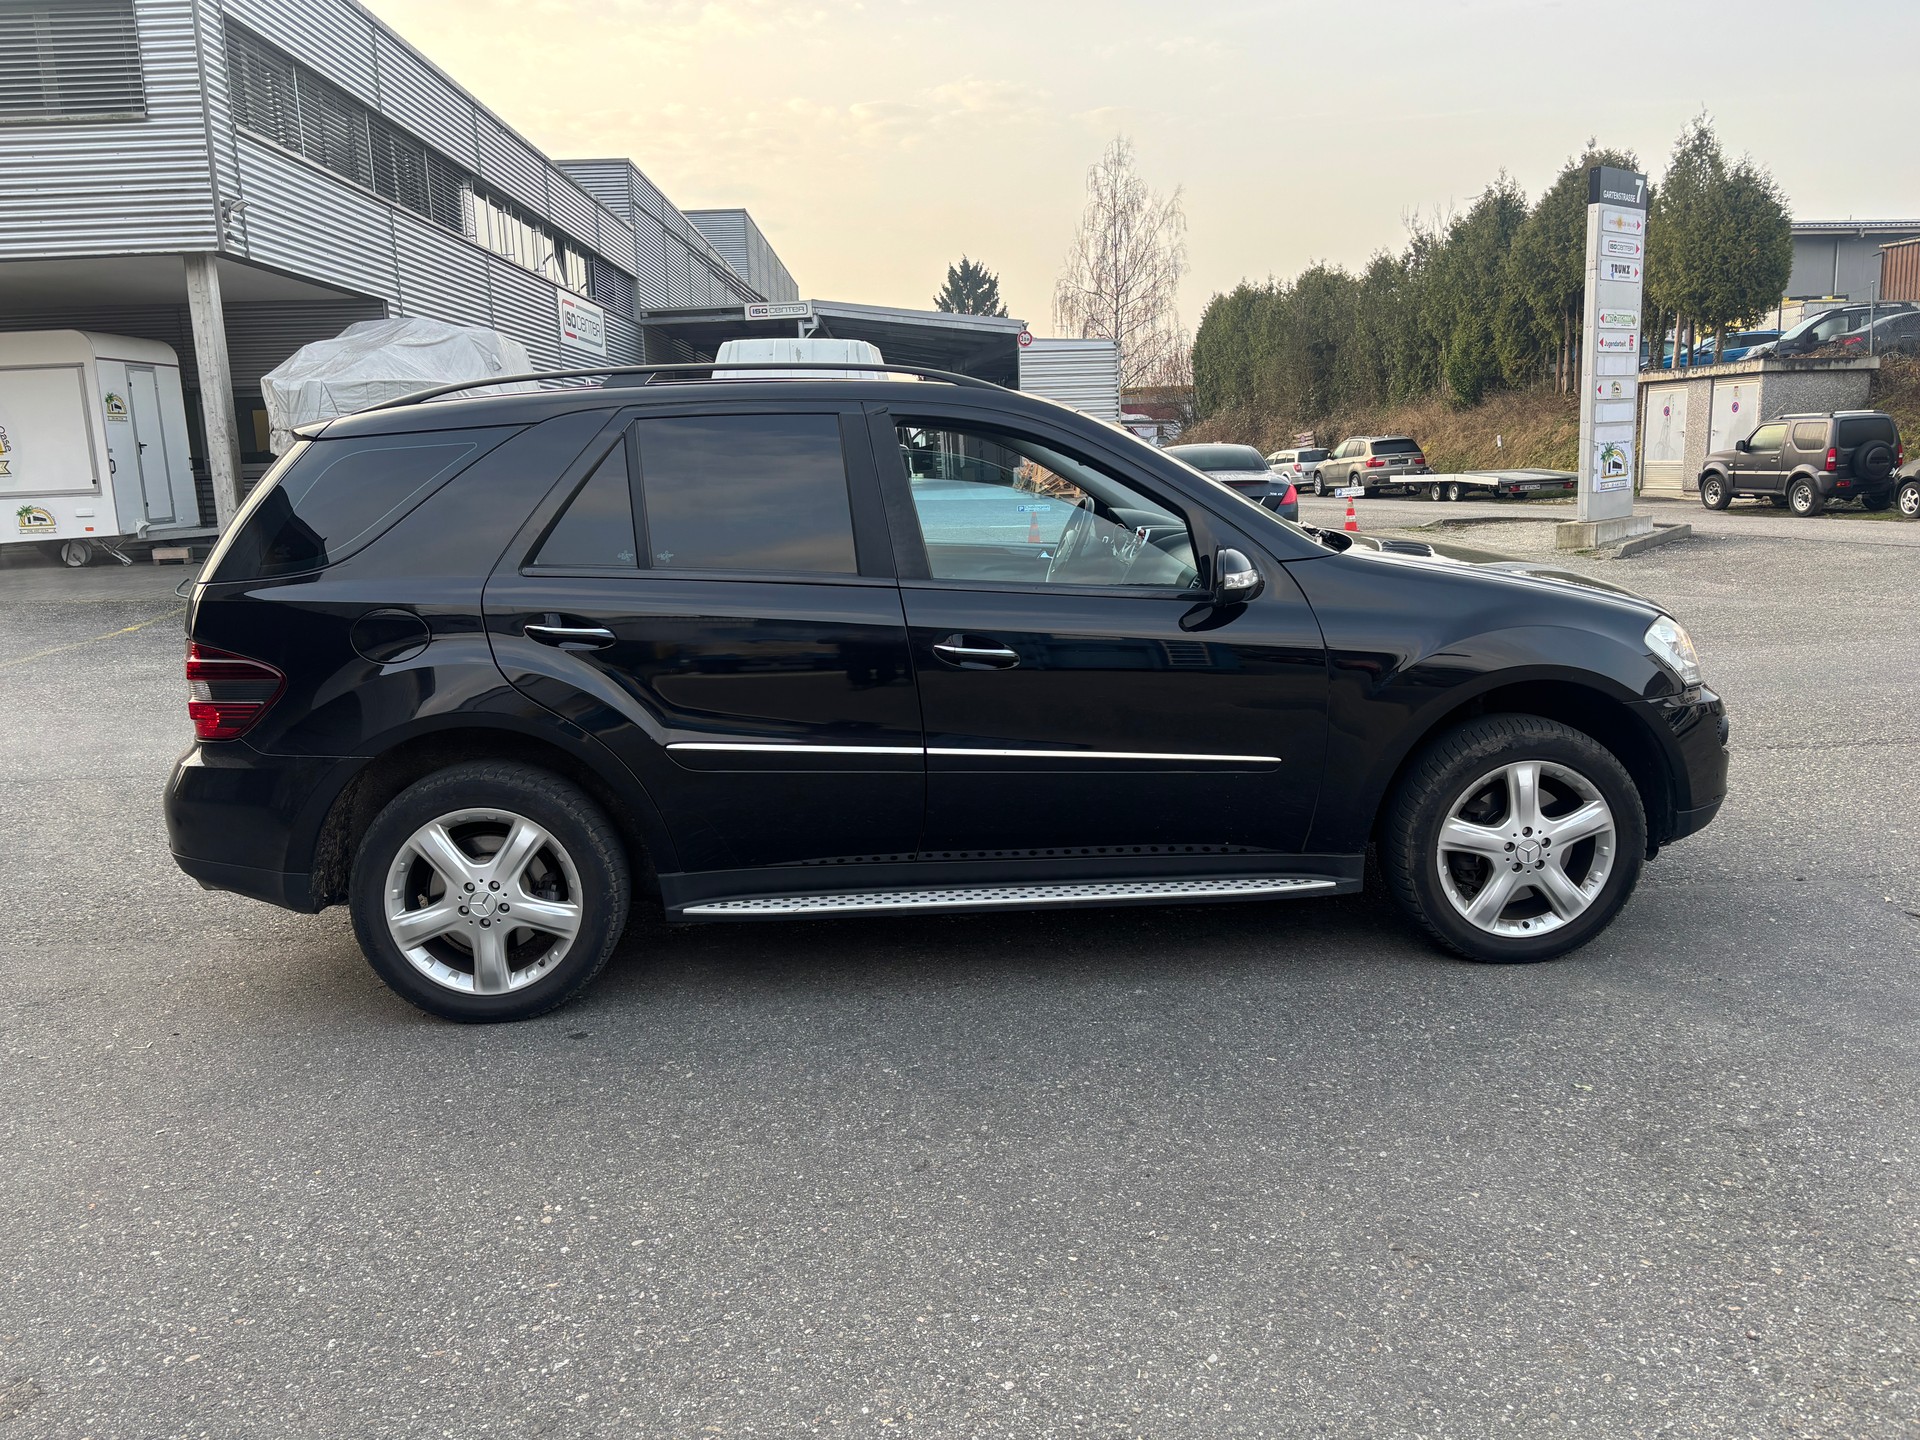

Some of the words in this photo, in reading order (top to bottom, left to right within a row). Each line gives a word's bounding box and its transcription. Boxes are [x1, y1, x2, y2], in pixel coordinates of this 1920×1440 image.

[1603, 189, 1636, 203] GARTENSTRASSE
[1635, 178, 1644, 204] 7
[1610, 263, 1631, 275] TRUNZ
[1604, 339, 1627, 349] Jugendarbeit
